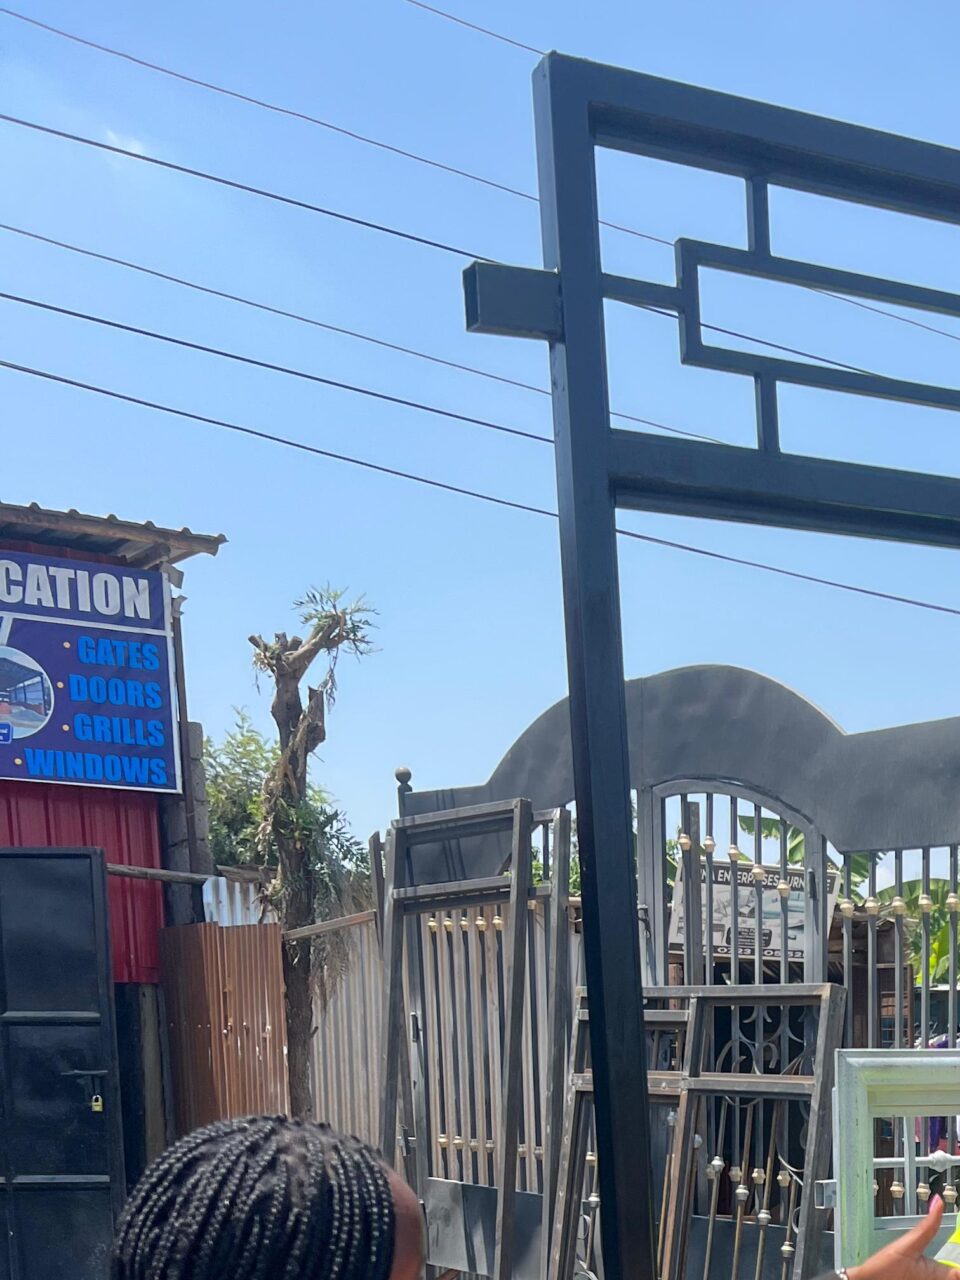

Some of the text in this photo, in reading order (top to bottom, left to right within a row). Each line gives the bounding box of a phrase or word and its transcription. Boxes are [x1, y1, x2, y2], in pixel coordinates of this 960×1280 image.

[0, 560, 150, 619] CATION
[77, 636, 160, 671] GATES
[68, 674, 162, 709] DOORS
[74, 713, 165, 747] GRILLS
[24, 748, 167, 785] WINDOWS
